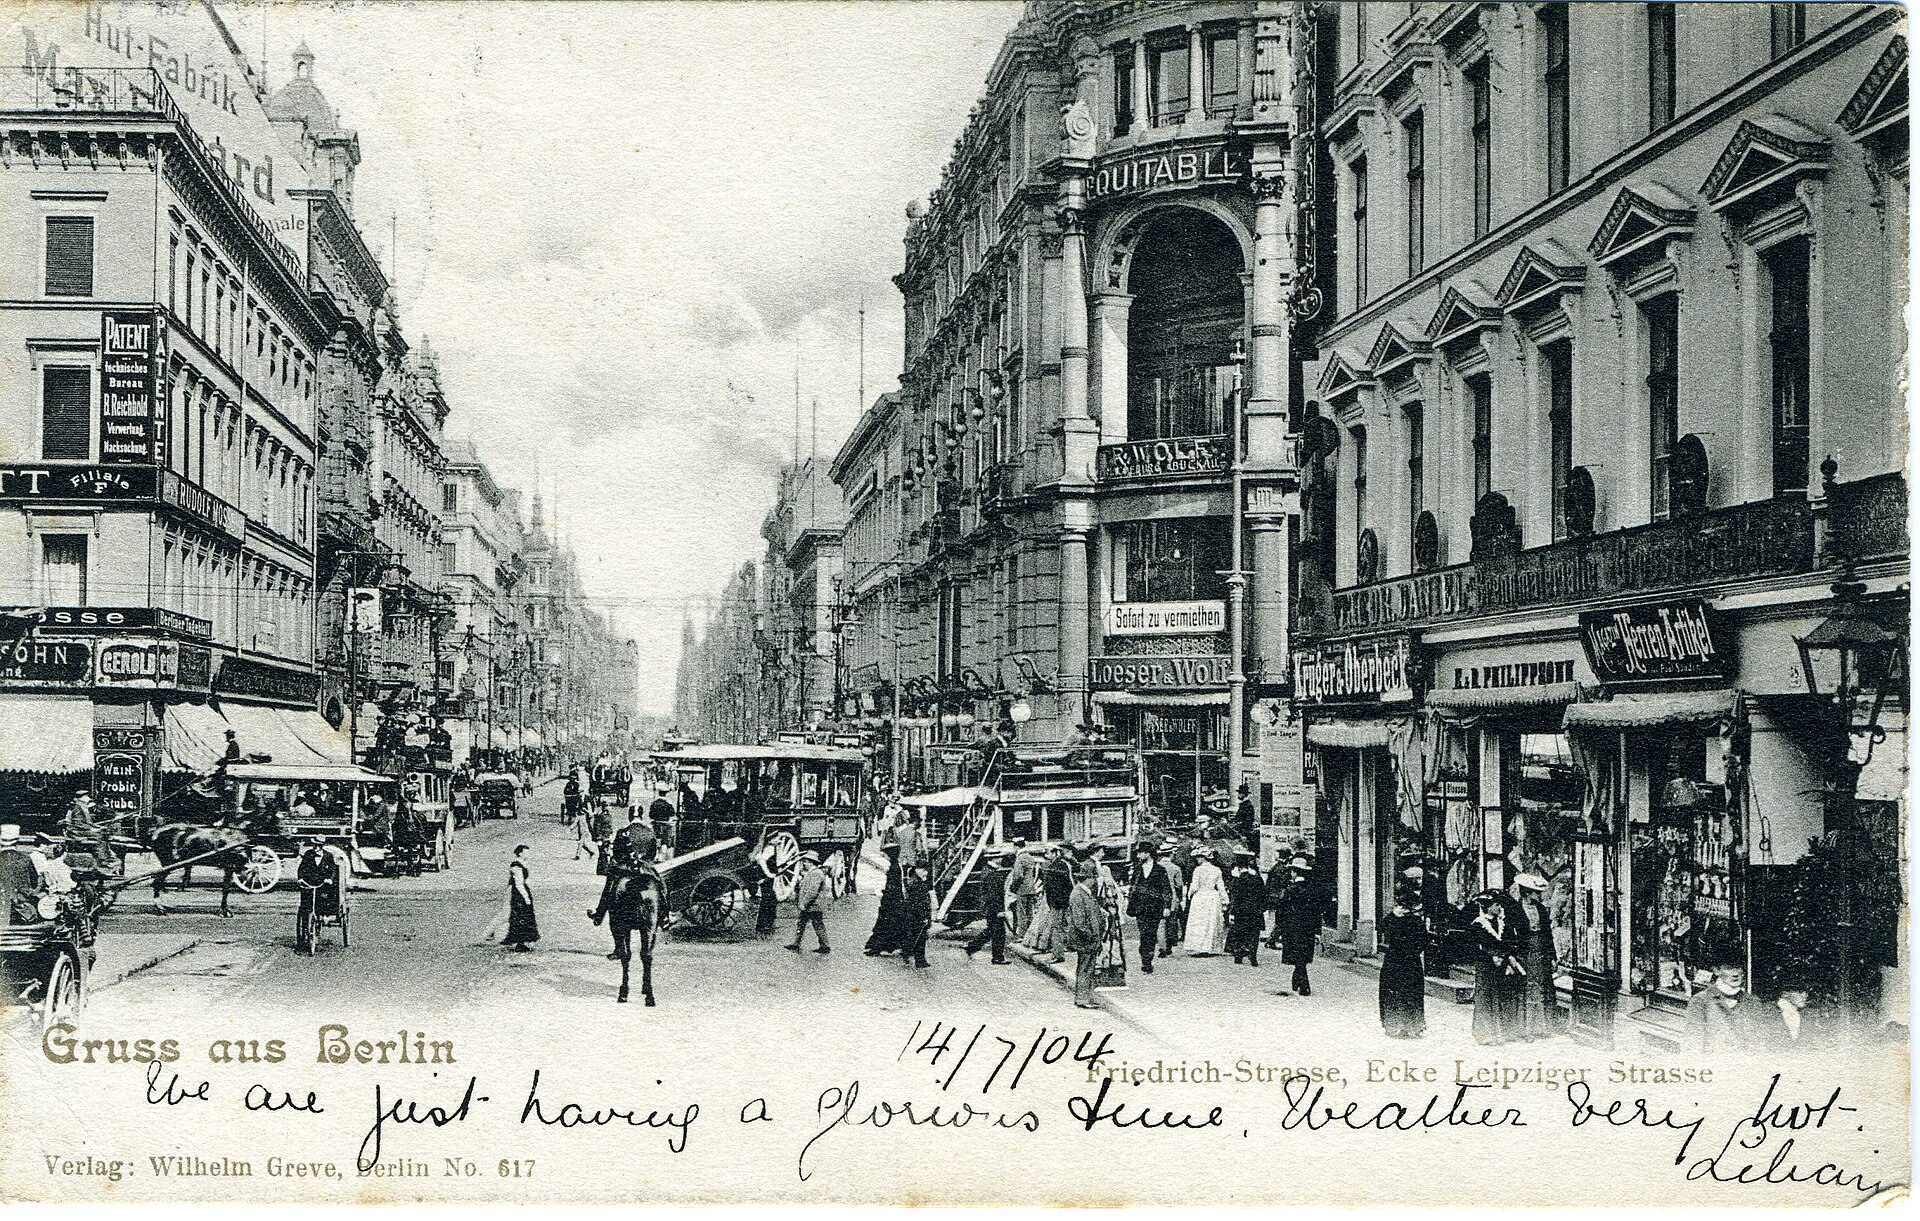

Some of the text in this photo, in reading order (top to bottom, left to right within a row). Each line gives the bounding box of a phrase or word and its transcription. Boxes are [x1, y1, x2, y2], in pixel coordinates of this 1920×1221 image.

[104, 316, 151, 354] PATENT
[105, 361, 148, 373] technisches
[109, 377, 143, 388] Bureau
[155, 316, 166, 460] PATENTE
[70, 469, 130, 488] Filiale
[94, 481, 108, 494] F
[179, 481, 212, 519] RUDOLF
[1115, 605, 1220, 629] Sofort zu vermiethen
[1090, 659, 1163, 684] Loeser
[1163, 672, 1174, 684] &
[1292, 650, 1336, 703] Krüger
[1344, 640, 1411, 696] Oberbeck
[898, 1020, 1115, 1094] 14/7/04
[146, 1060, 210, 1106] We
[244, 1084, 326, 1111] are
[357, 1070, 490, 1172] just
[520, 1069, 700, 1153] having
[741, 1097, 773, 1123] a
[1281, 1074, 1529, 1131] Weather
